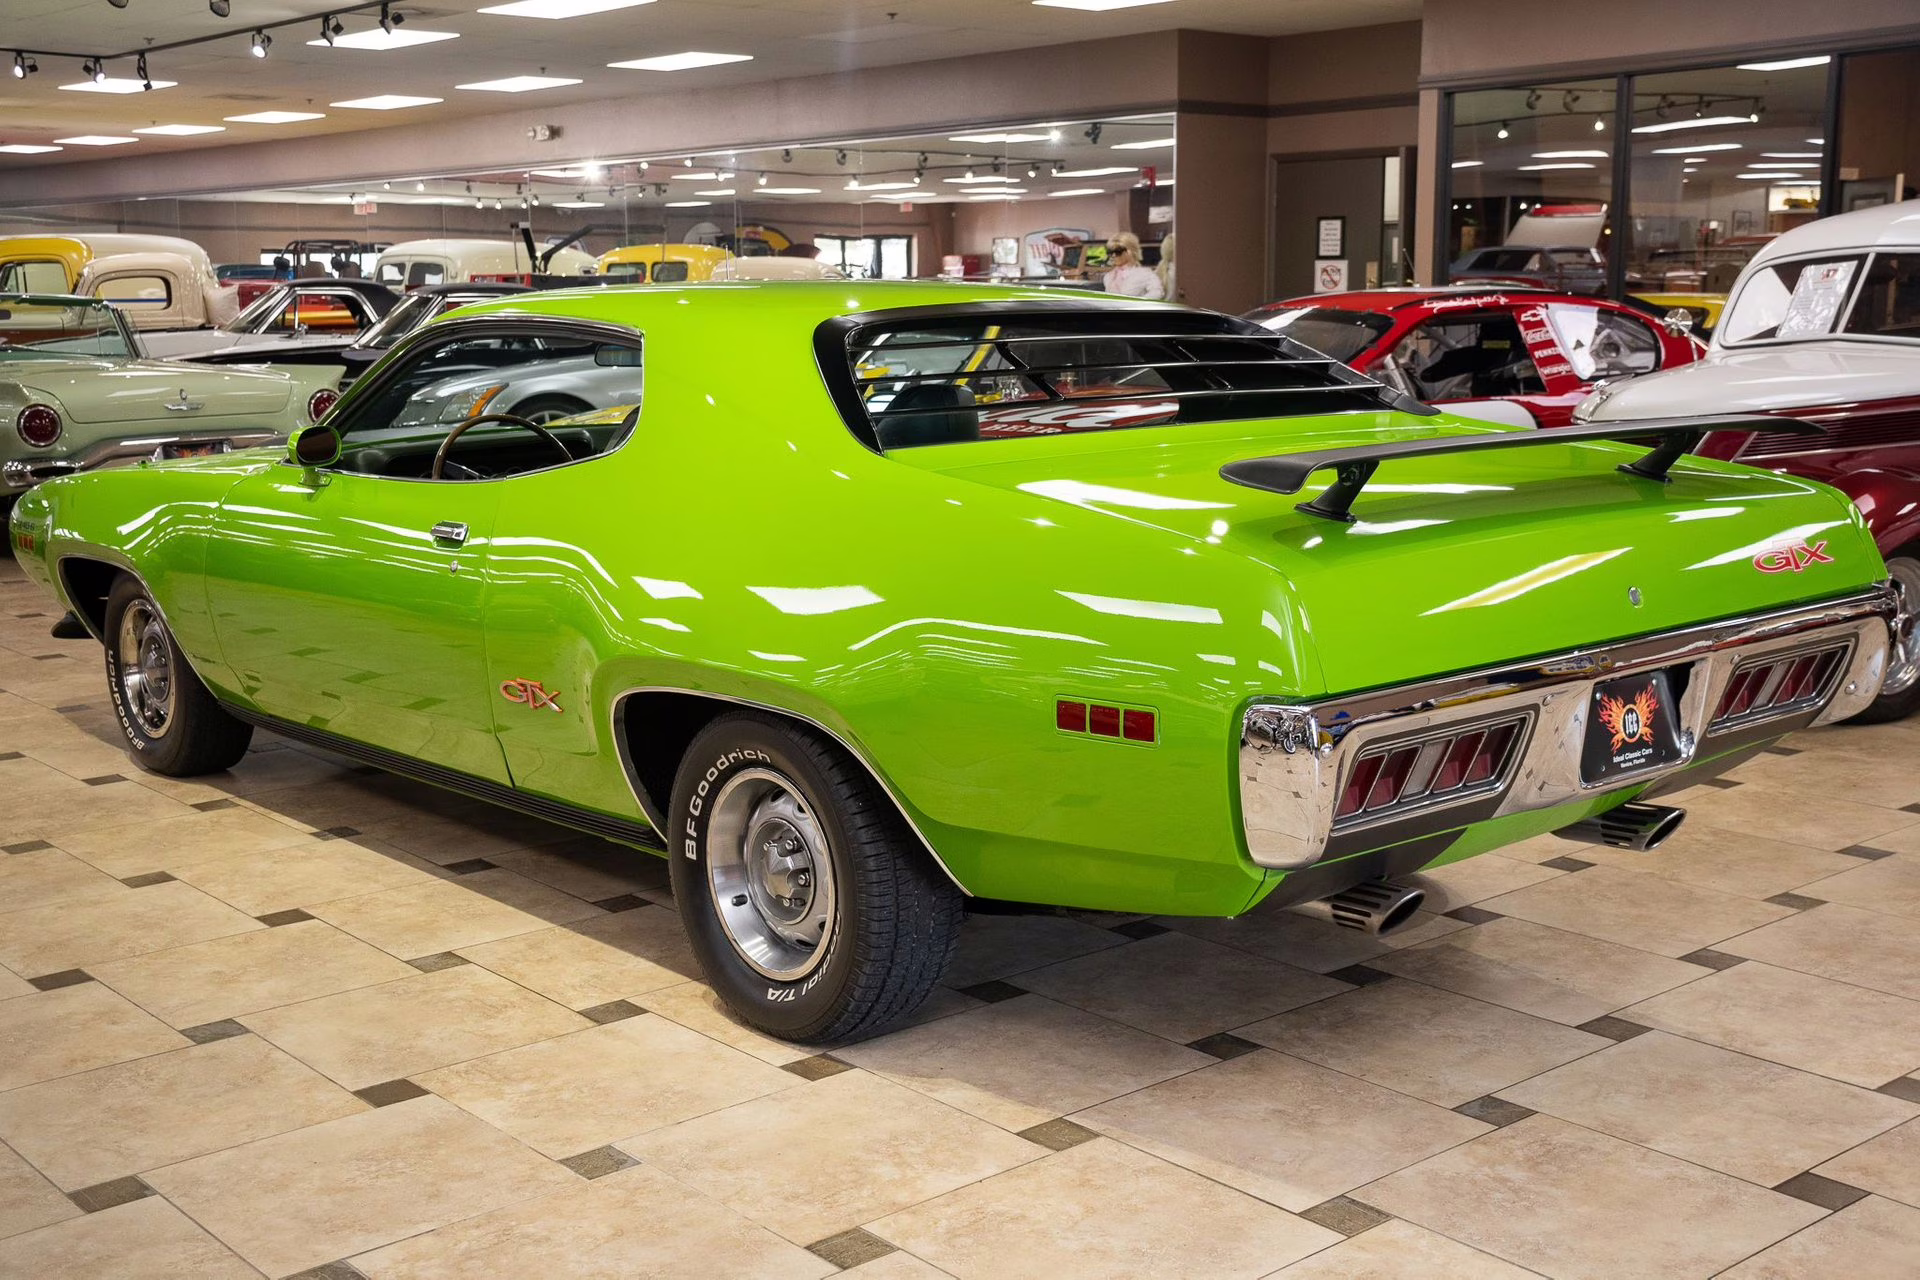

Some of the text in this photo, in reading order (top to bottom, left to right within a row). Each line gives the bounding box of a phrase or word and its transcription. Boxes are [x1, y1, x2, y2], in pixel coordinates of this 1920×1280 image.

[1753, 541, 1834, 573] GTX
[108, 650, 145, 750] BFGoodrich
[500, 678, 563, 713] GTX
[1613, 755, 1624, 763] Ideal
[1625, 751, 1641, 760] Classic
[685, 748, 771, 861] BFGoodrich
[767, 988, 795, 1002] T/A
